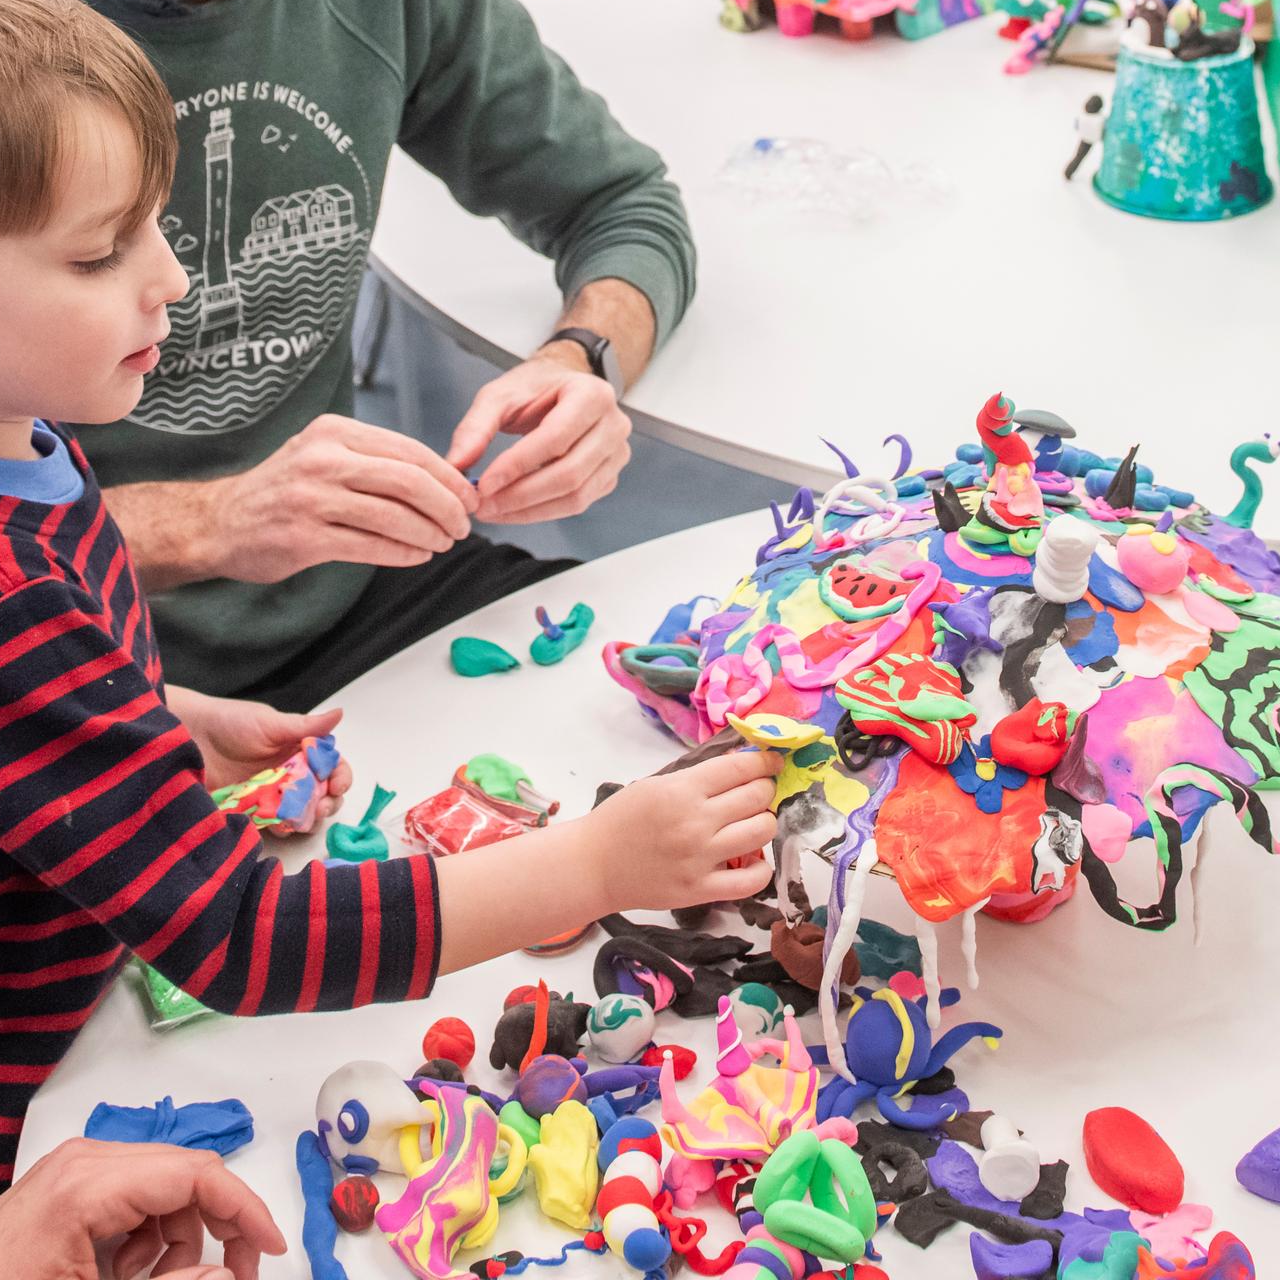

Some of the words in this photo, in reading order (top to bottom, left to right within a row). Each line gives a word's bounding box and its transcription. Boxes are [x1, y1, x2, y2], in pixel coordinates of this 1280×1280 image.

[175, 81, 248, 120] RYONE
[253, 81, 270, 100] IS
[273, 83, 353, 154] WELCOME
